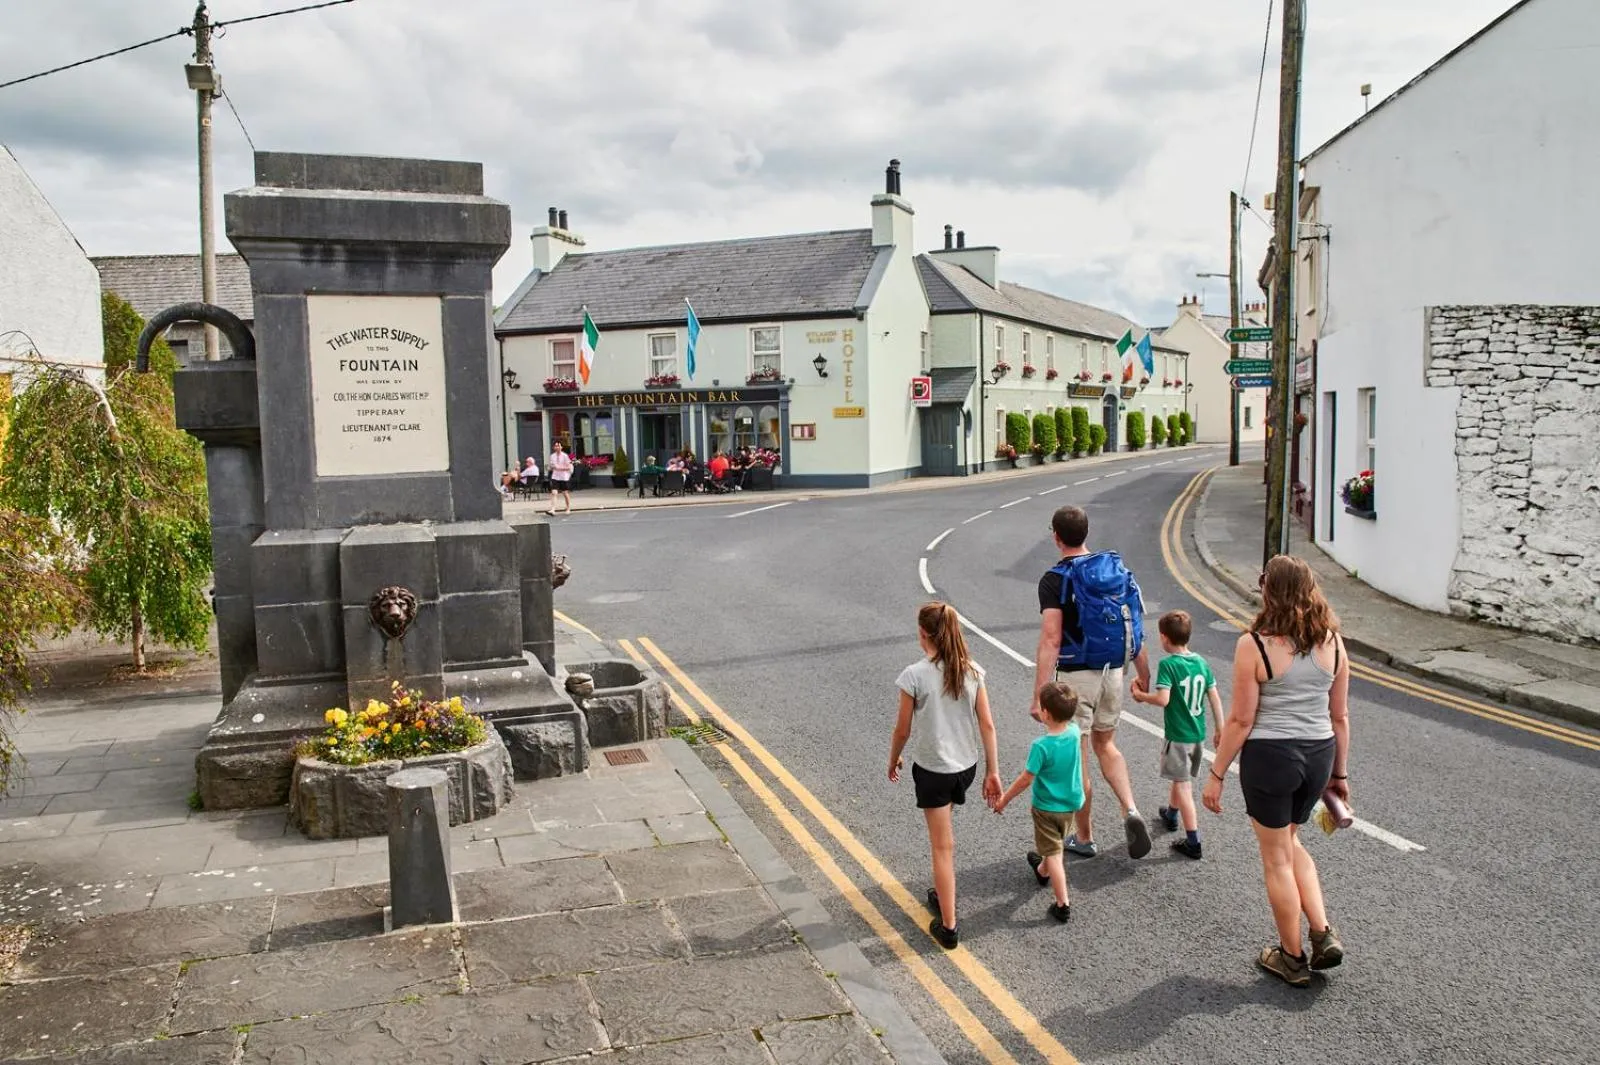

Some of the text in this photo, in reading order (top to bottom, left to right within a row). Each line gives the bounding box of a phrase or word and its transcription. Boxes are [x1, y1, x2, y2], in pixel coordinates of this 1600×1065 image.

[326, 327, 429, 350] THE WATER SUPPLY
[340, 360, 418, 371] FOUNTAIN
[842, 329, 854, 403] HOTEL
[373, 392, 399, 401] CHARLES
[574, 390, 742, 407] THE FOUNTAIN BAR
[342, 423, 391, 432] LIEUTENANT
[399, 423, 421, 431] CLARE
[1180, 674, 1205, 716] 10
